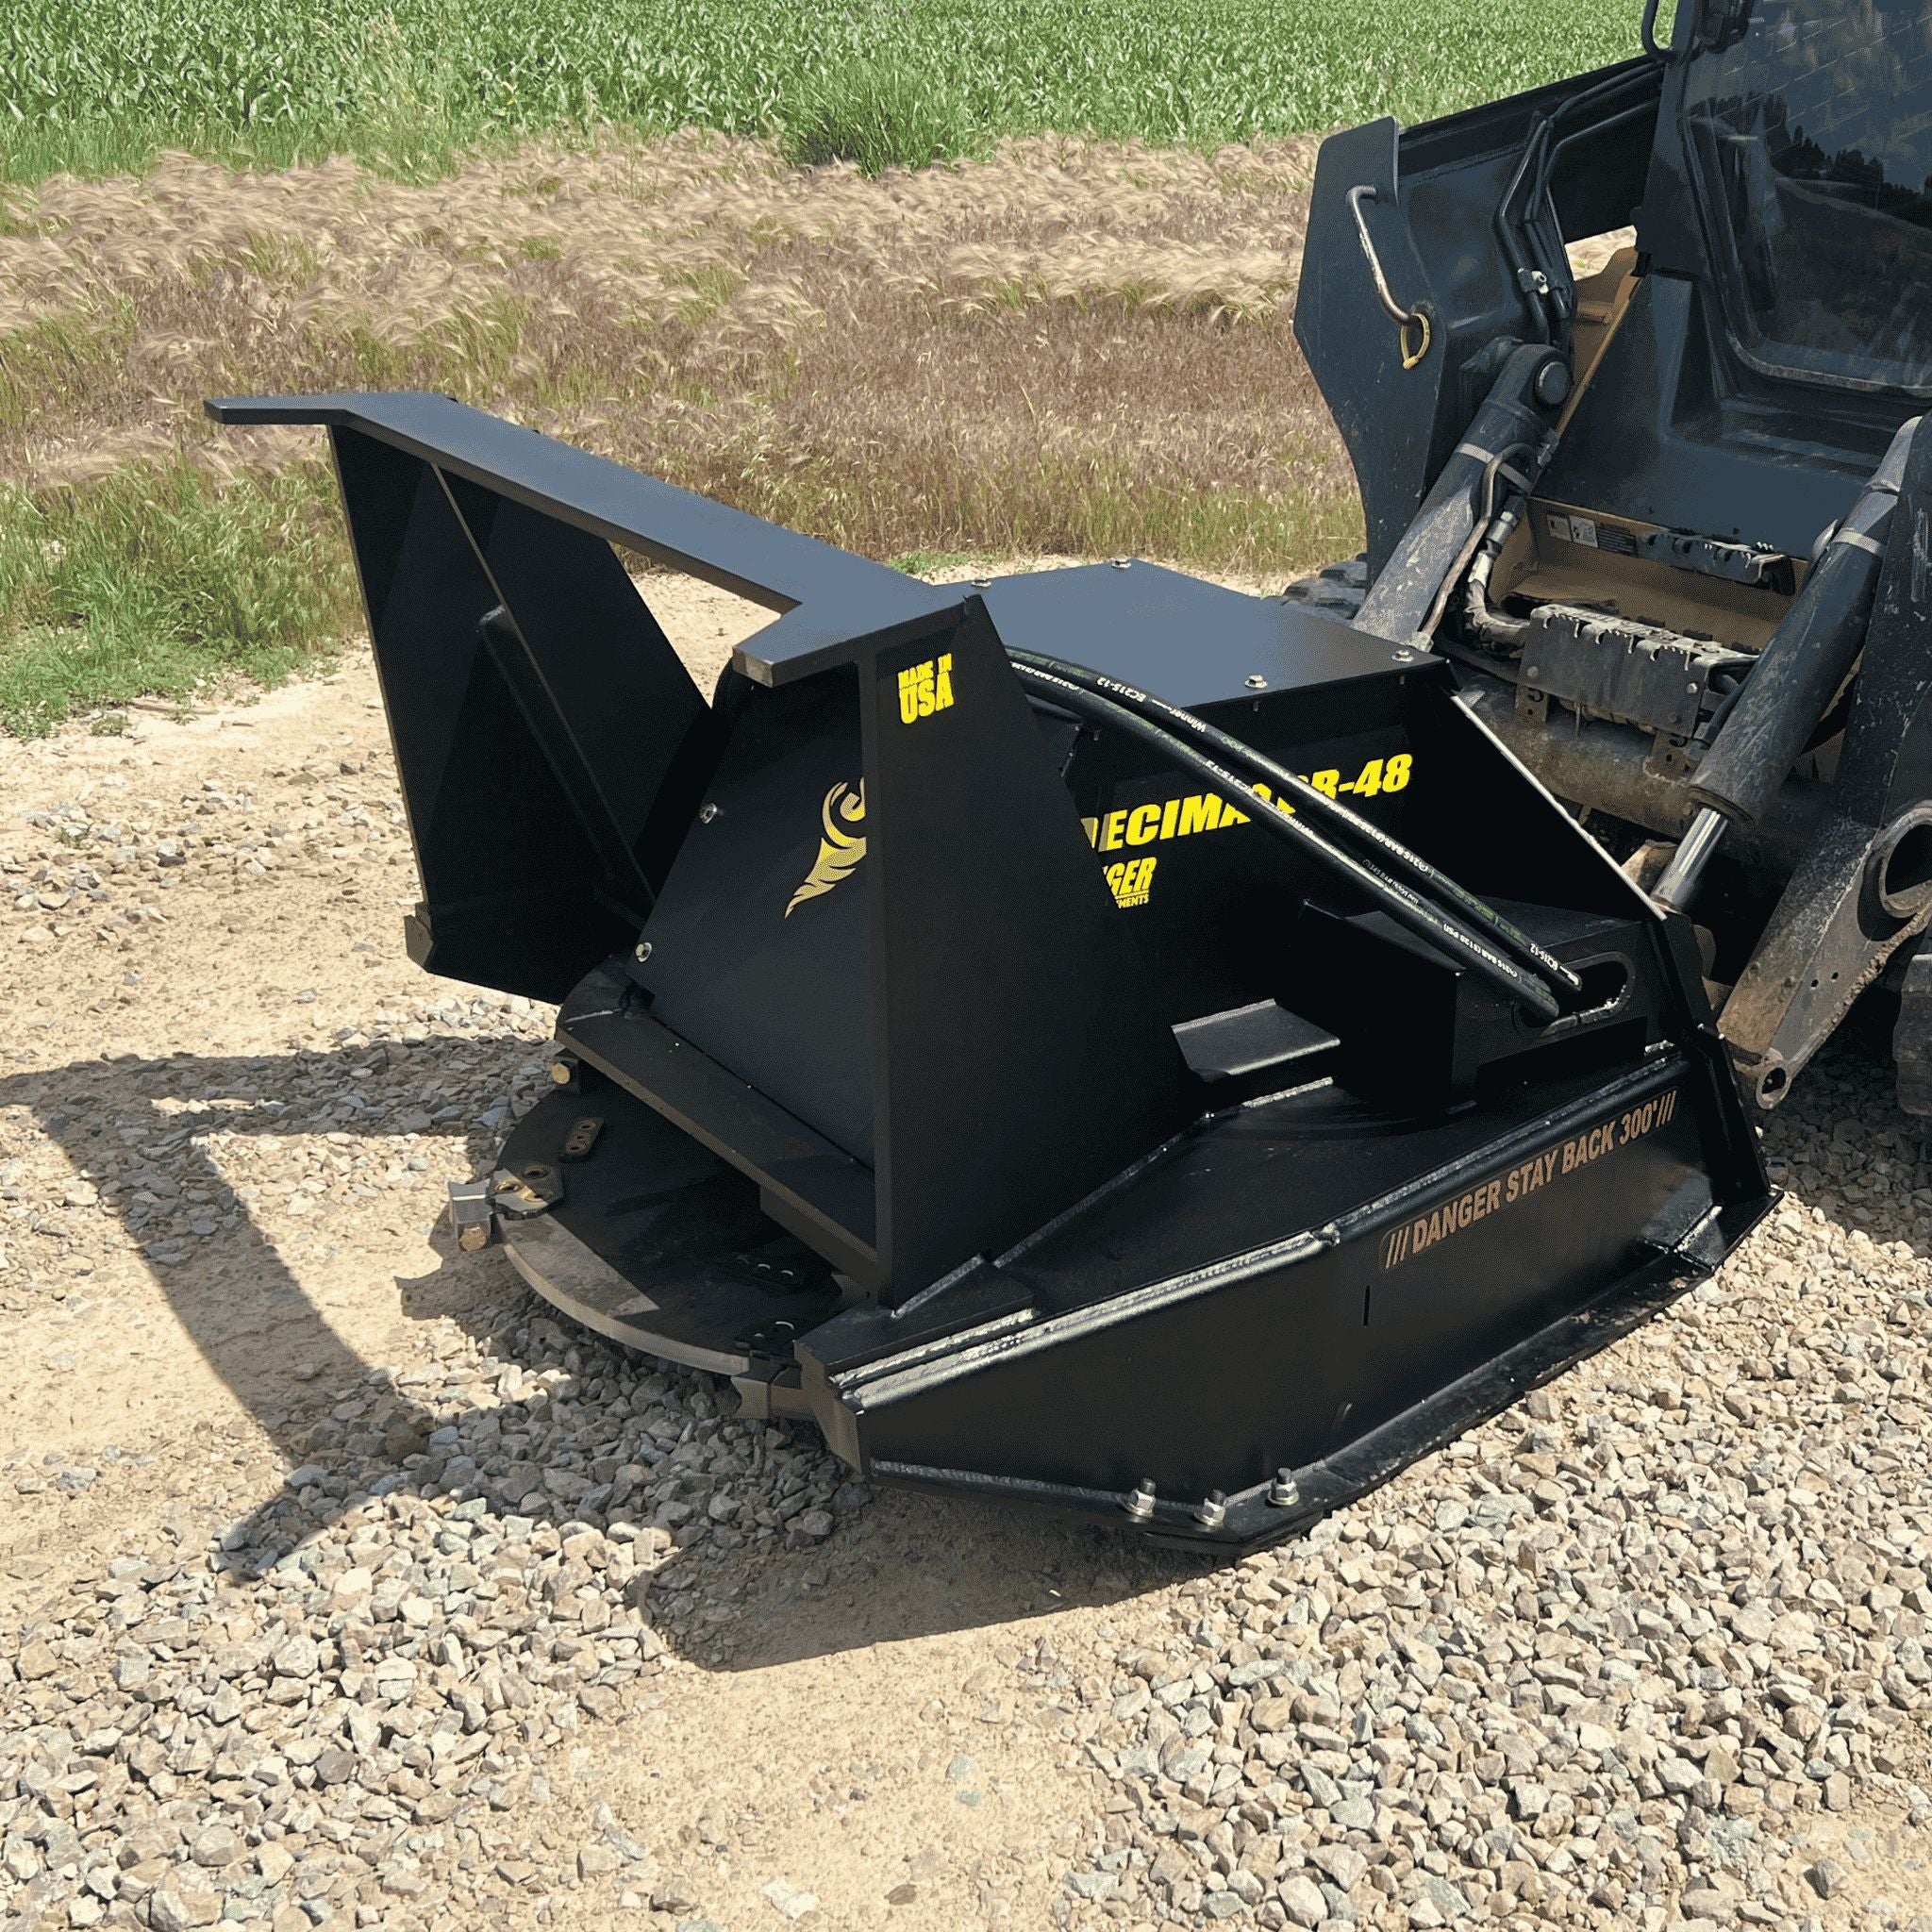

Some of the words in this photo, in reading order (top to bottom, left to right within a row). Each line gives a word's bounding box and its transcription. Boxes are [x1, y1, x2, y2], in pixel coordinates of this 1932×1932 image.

[899, 671, 955, 724] USA
[1096, 676, 1147, 703] EC215-12
[1102, 857, 1158, 896] GER
[1411, 1179, 1502, 1255] DANGER
[1506, 1149, 1558, 1204] STAY
[1561, 1120, 1617, 1174] BACK
